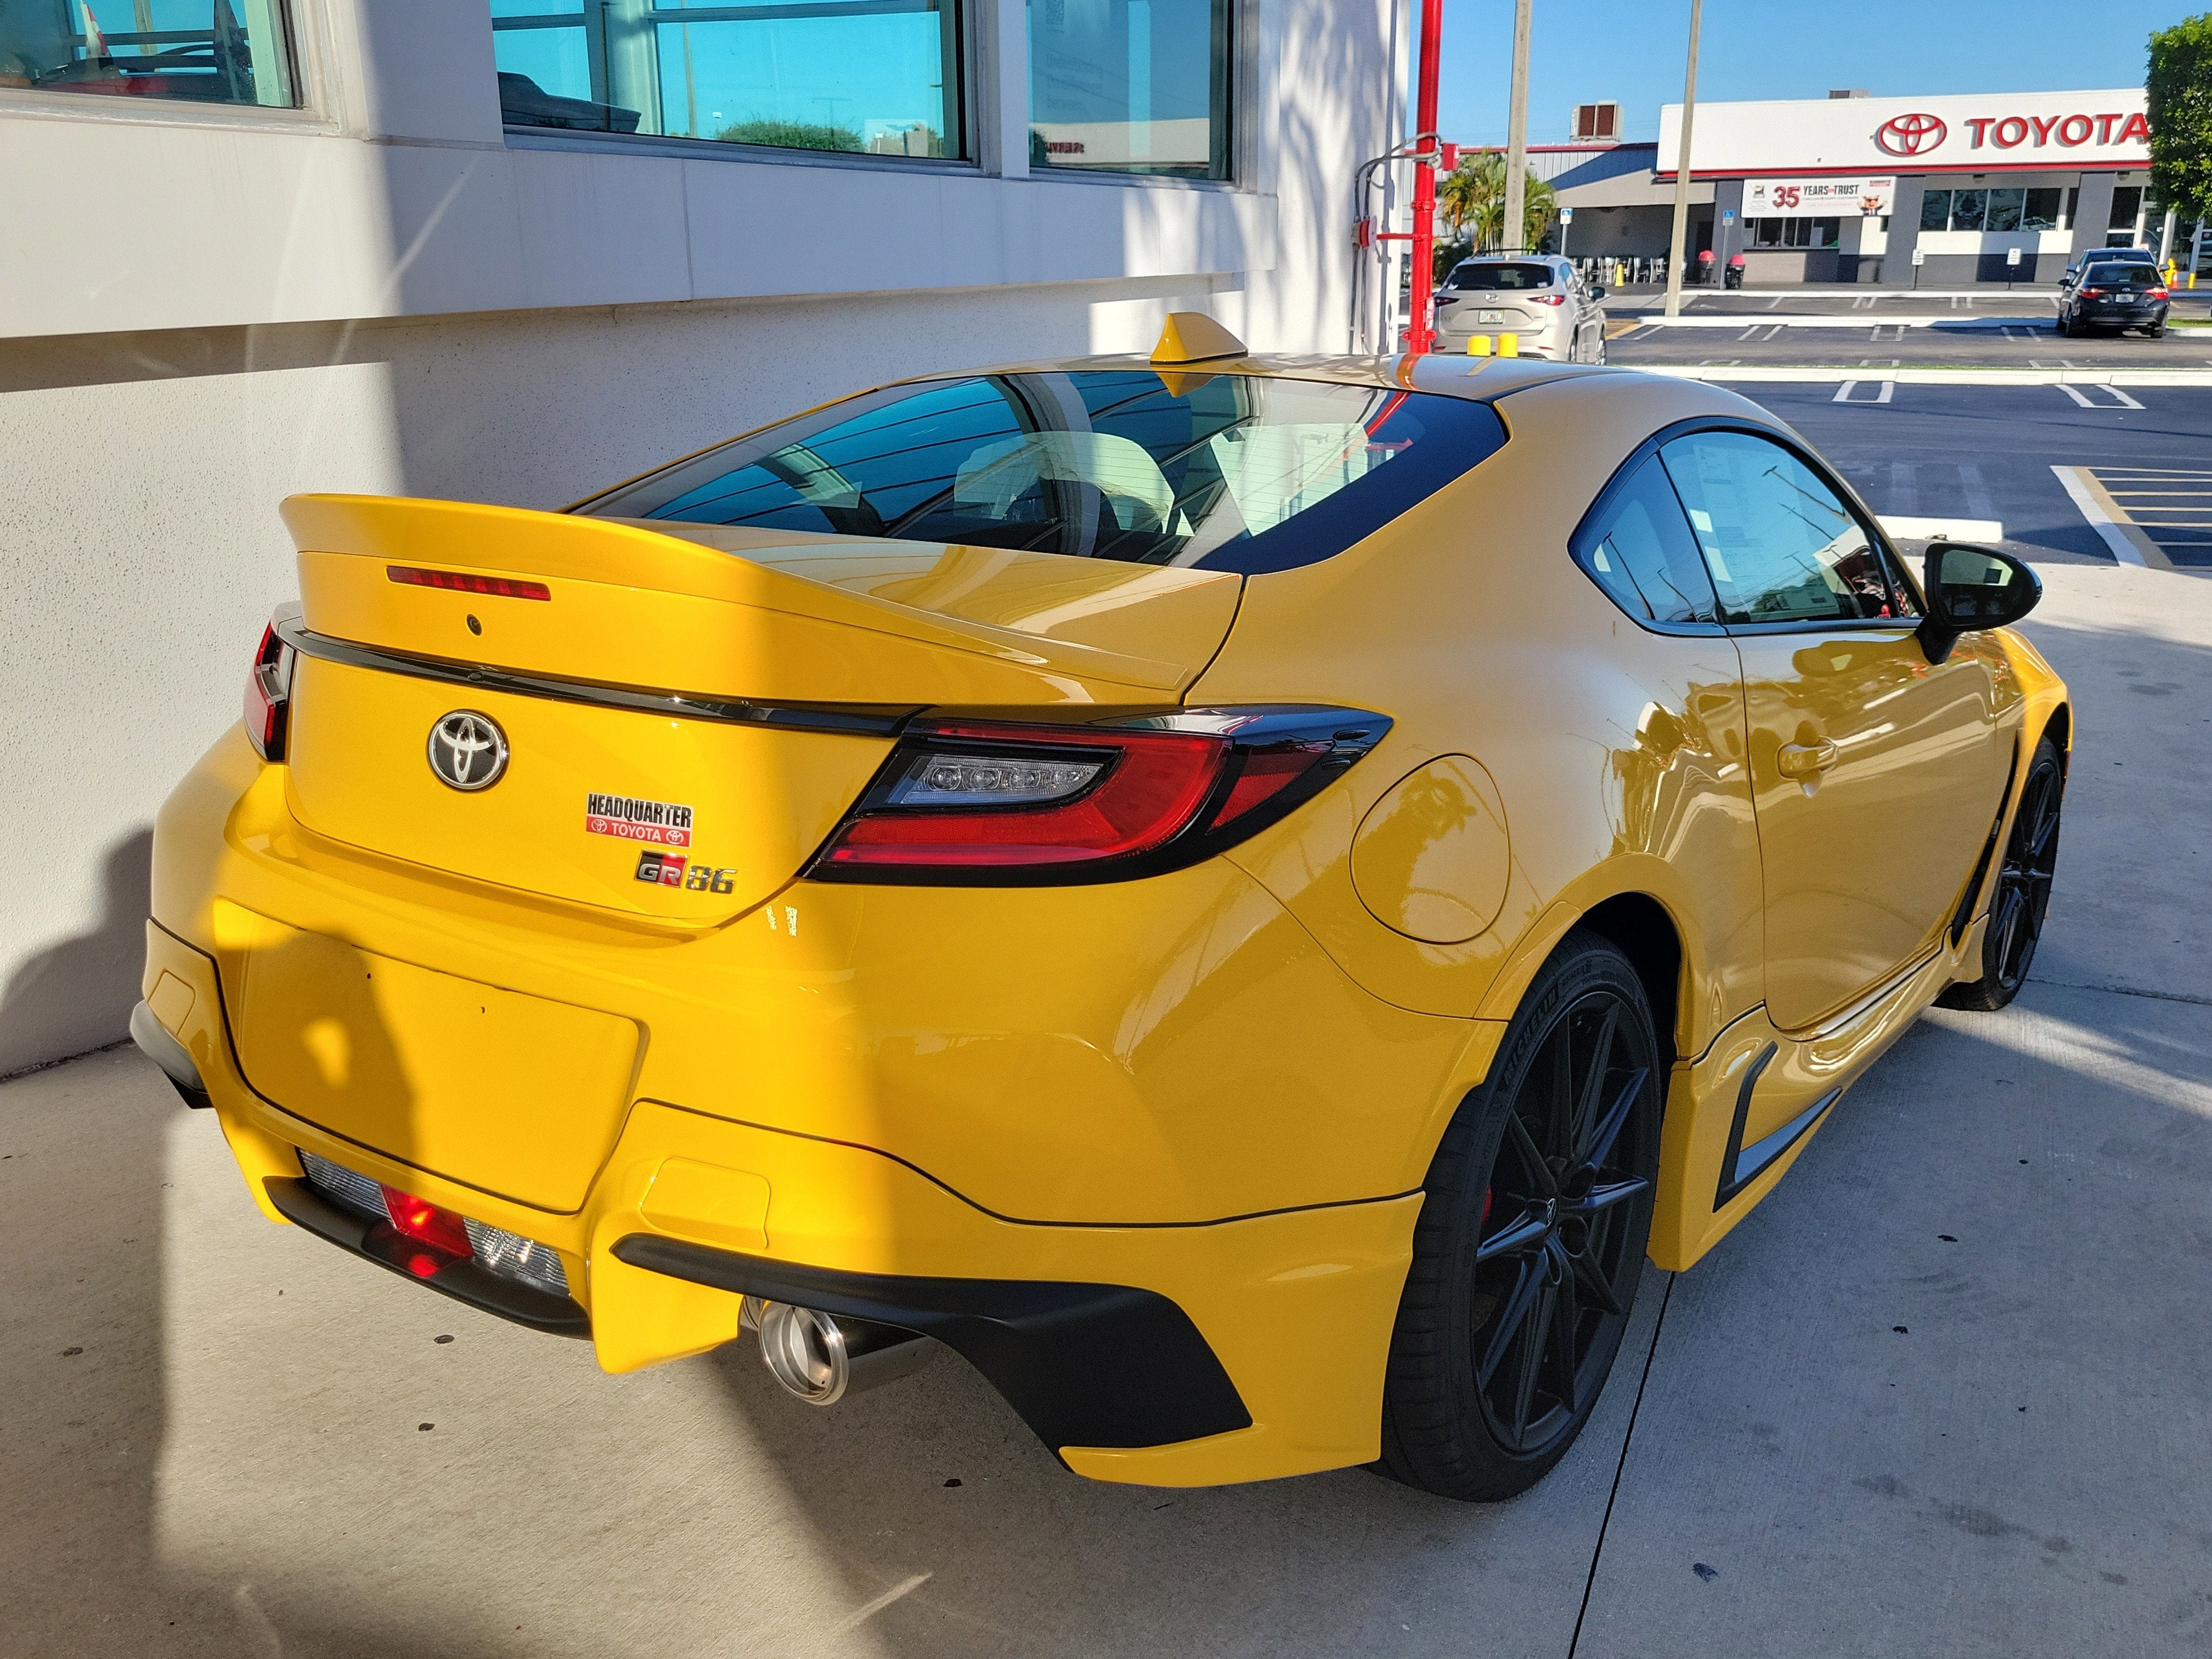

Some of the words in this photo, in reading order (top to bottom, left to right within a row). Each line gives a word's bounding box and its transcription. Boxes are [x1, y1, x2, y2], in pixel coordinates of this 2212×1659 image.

[1965, 112, 2150, 149] TOYOTA
[1773, 186, 1801, 207] 35
[1803, 185, 1829, 195] YEARS
[1833, 184, 1860, 195] TRUST
[588, 793, 692, 828] HEADQUARTER
[612, 822, 662, 842] TOYOTA
[1503, 989, 1558, 1085] MICHELIN
